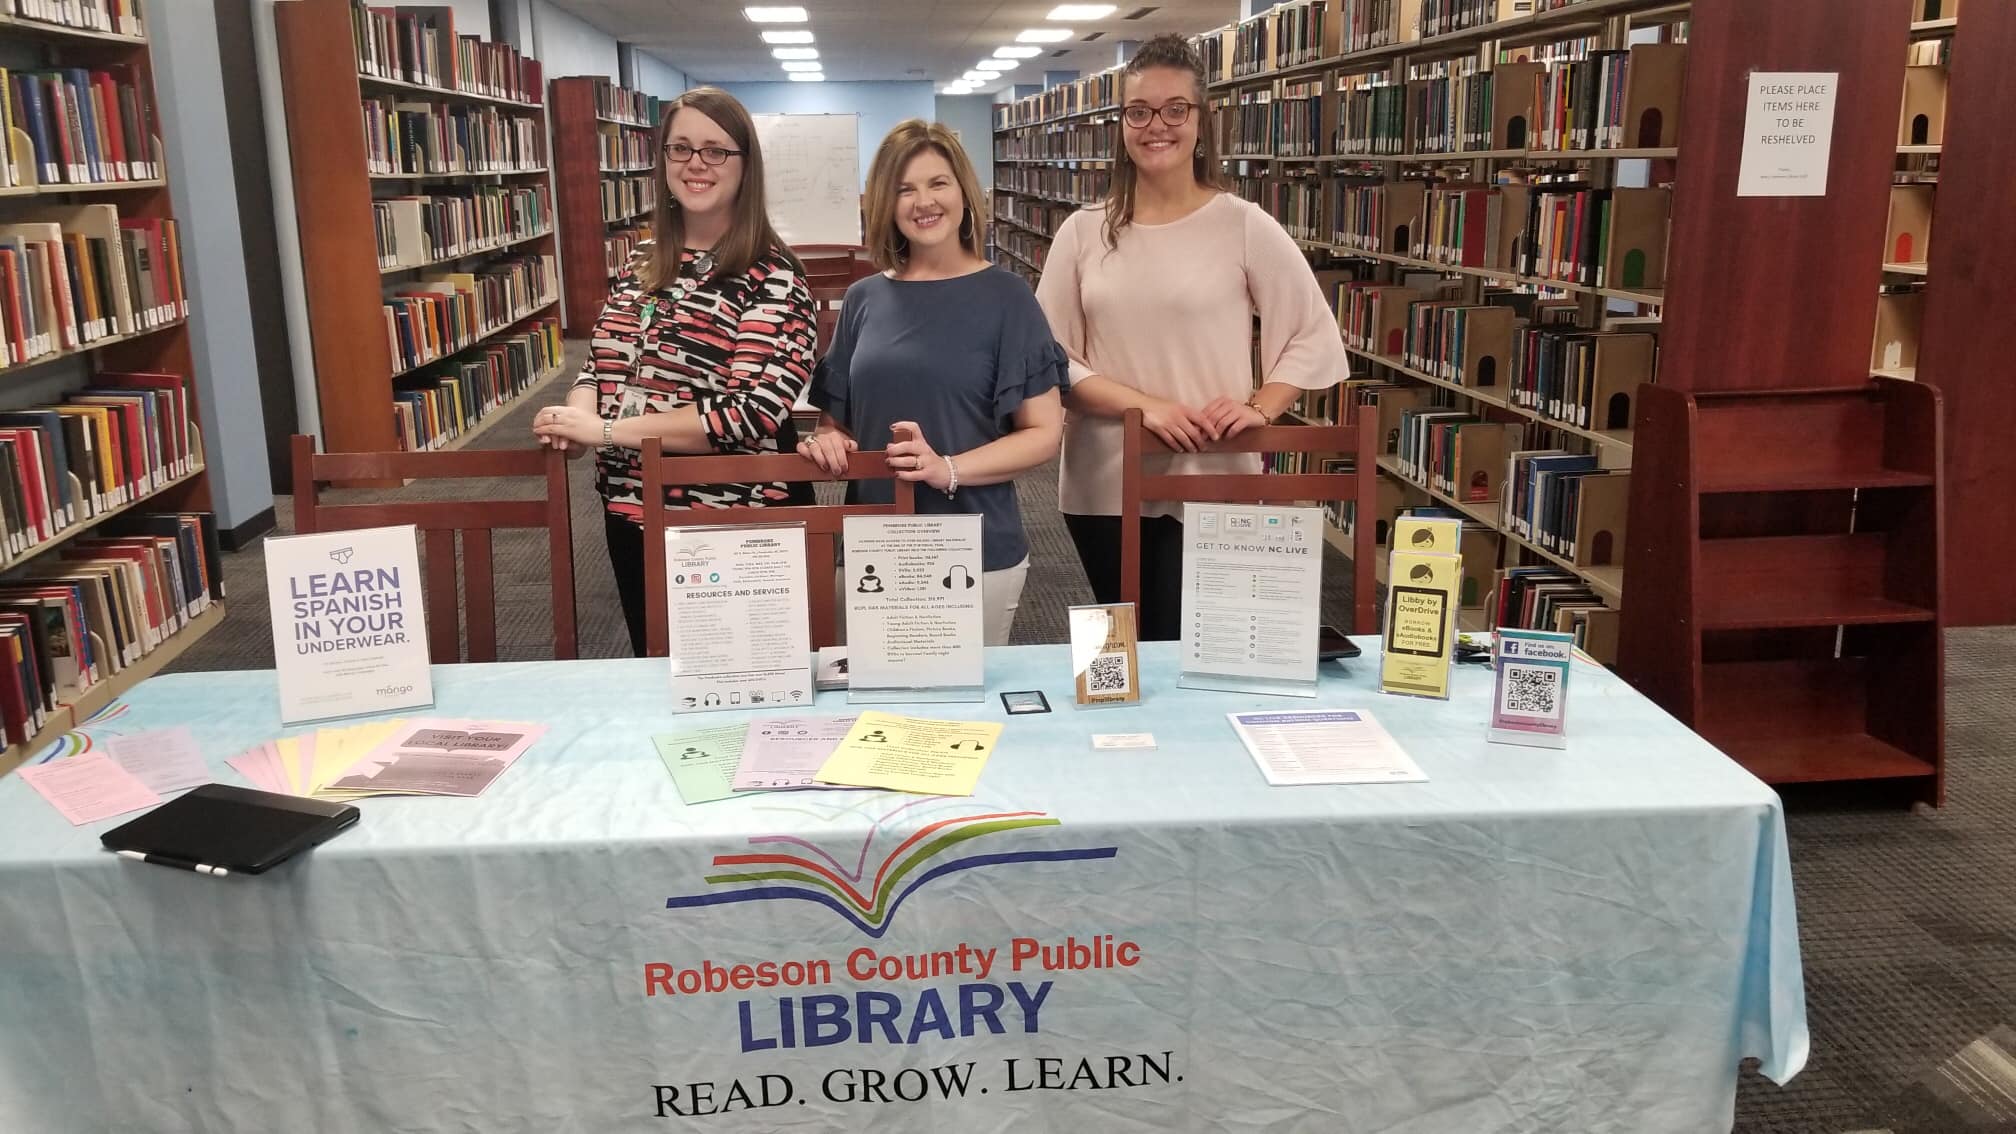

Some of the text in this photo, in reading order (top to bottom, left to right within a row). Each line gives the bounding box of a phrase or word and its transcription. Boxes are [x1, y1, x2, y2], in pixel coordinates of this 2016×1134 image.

[1760, 85, 1826, 94] PLEASE PLACE
[1763, 102, 1820, 112] ITEMS HERE
[1776, 118, 1804, 128] TO BE
[1761, 135, 1816, 144] RESHELVED
[290, 566, 400, 599] LEARN
[686, 591, 732, 599] RESOURCES
[1402, 595, 1425, 605] Libby
[294, 592, 402, 619] SPANISH
[1399, 605, 1439, 615] OverDrive
[294, 612, 404, 640] IN YOUR
[297, 632, 410, 655] UNDERWEAR.
[1524, 648, 1567, 658] facebook.
[644, 935, 1142, 997] Robeson County Public
[737, 981, 1054, 1054] LIBRARY
[650, 1051, 1184, 1118] READ. GROW. LEARN.
